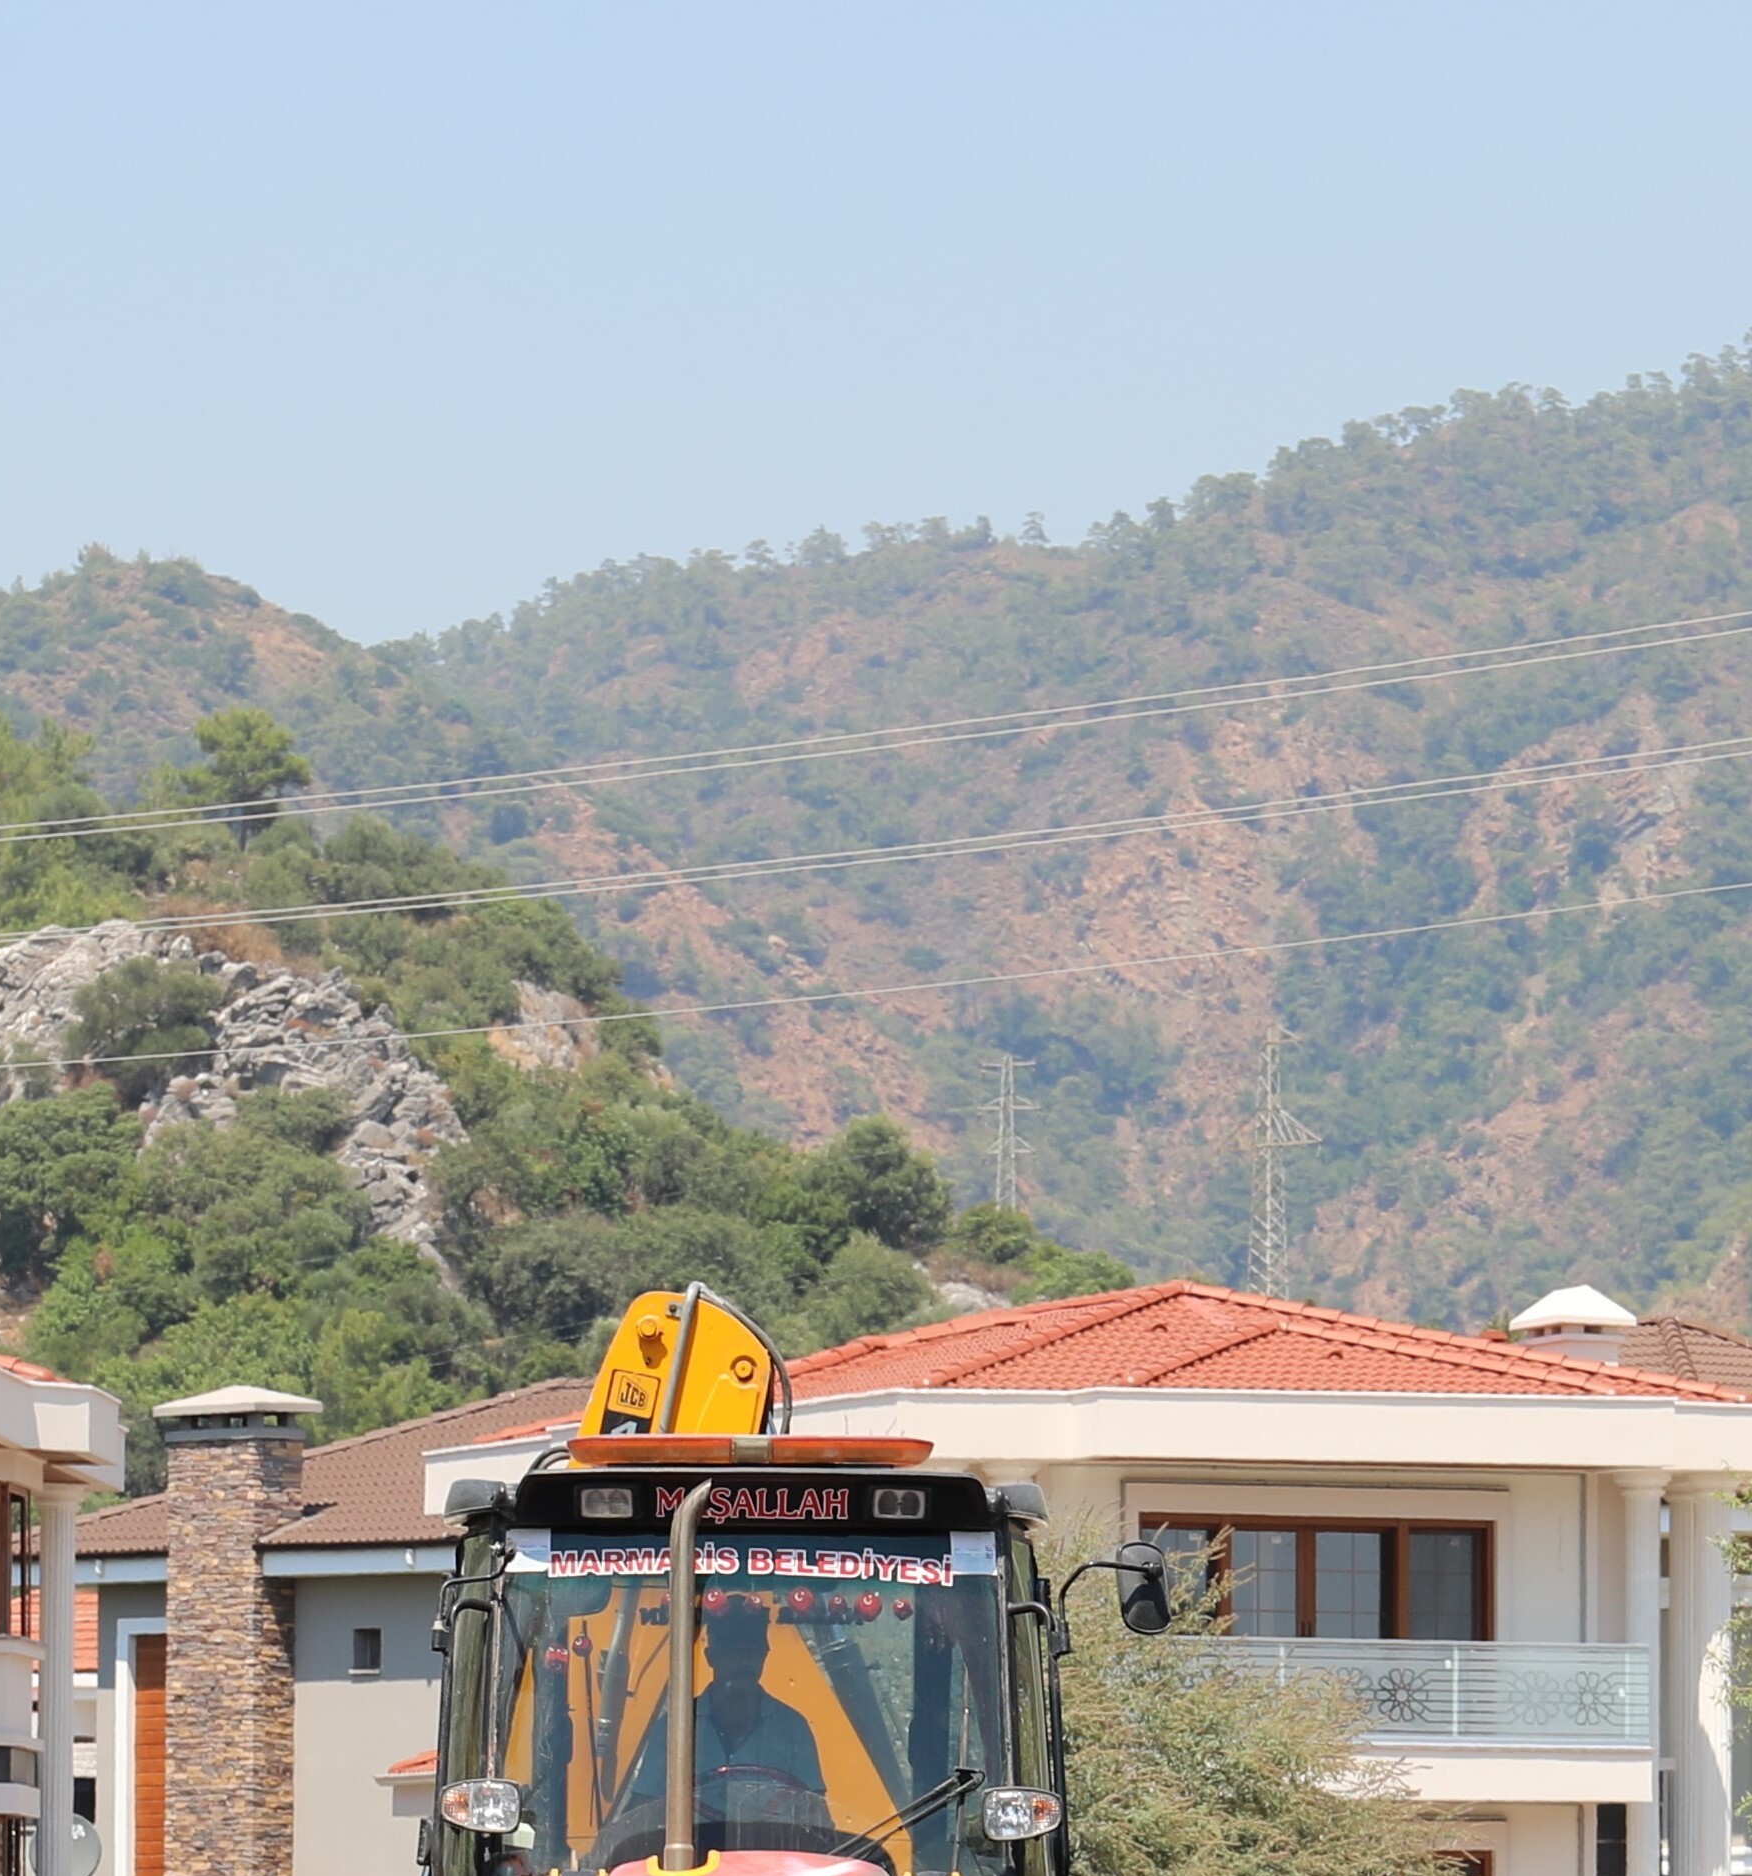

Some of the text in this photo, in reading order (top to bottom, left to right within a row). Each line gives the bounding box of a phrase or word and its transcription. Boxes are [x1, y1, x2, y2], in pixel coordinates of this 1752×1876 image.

[620, 1382, 647, 1408] JCB
[655, 1486, 849, 1524] MŞALLAH
[747, 1547, 954, 1587] BELEDİYESİ
